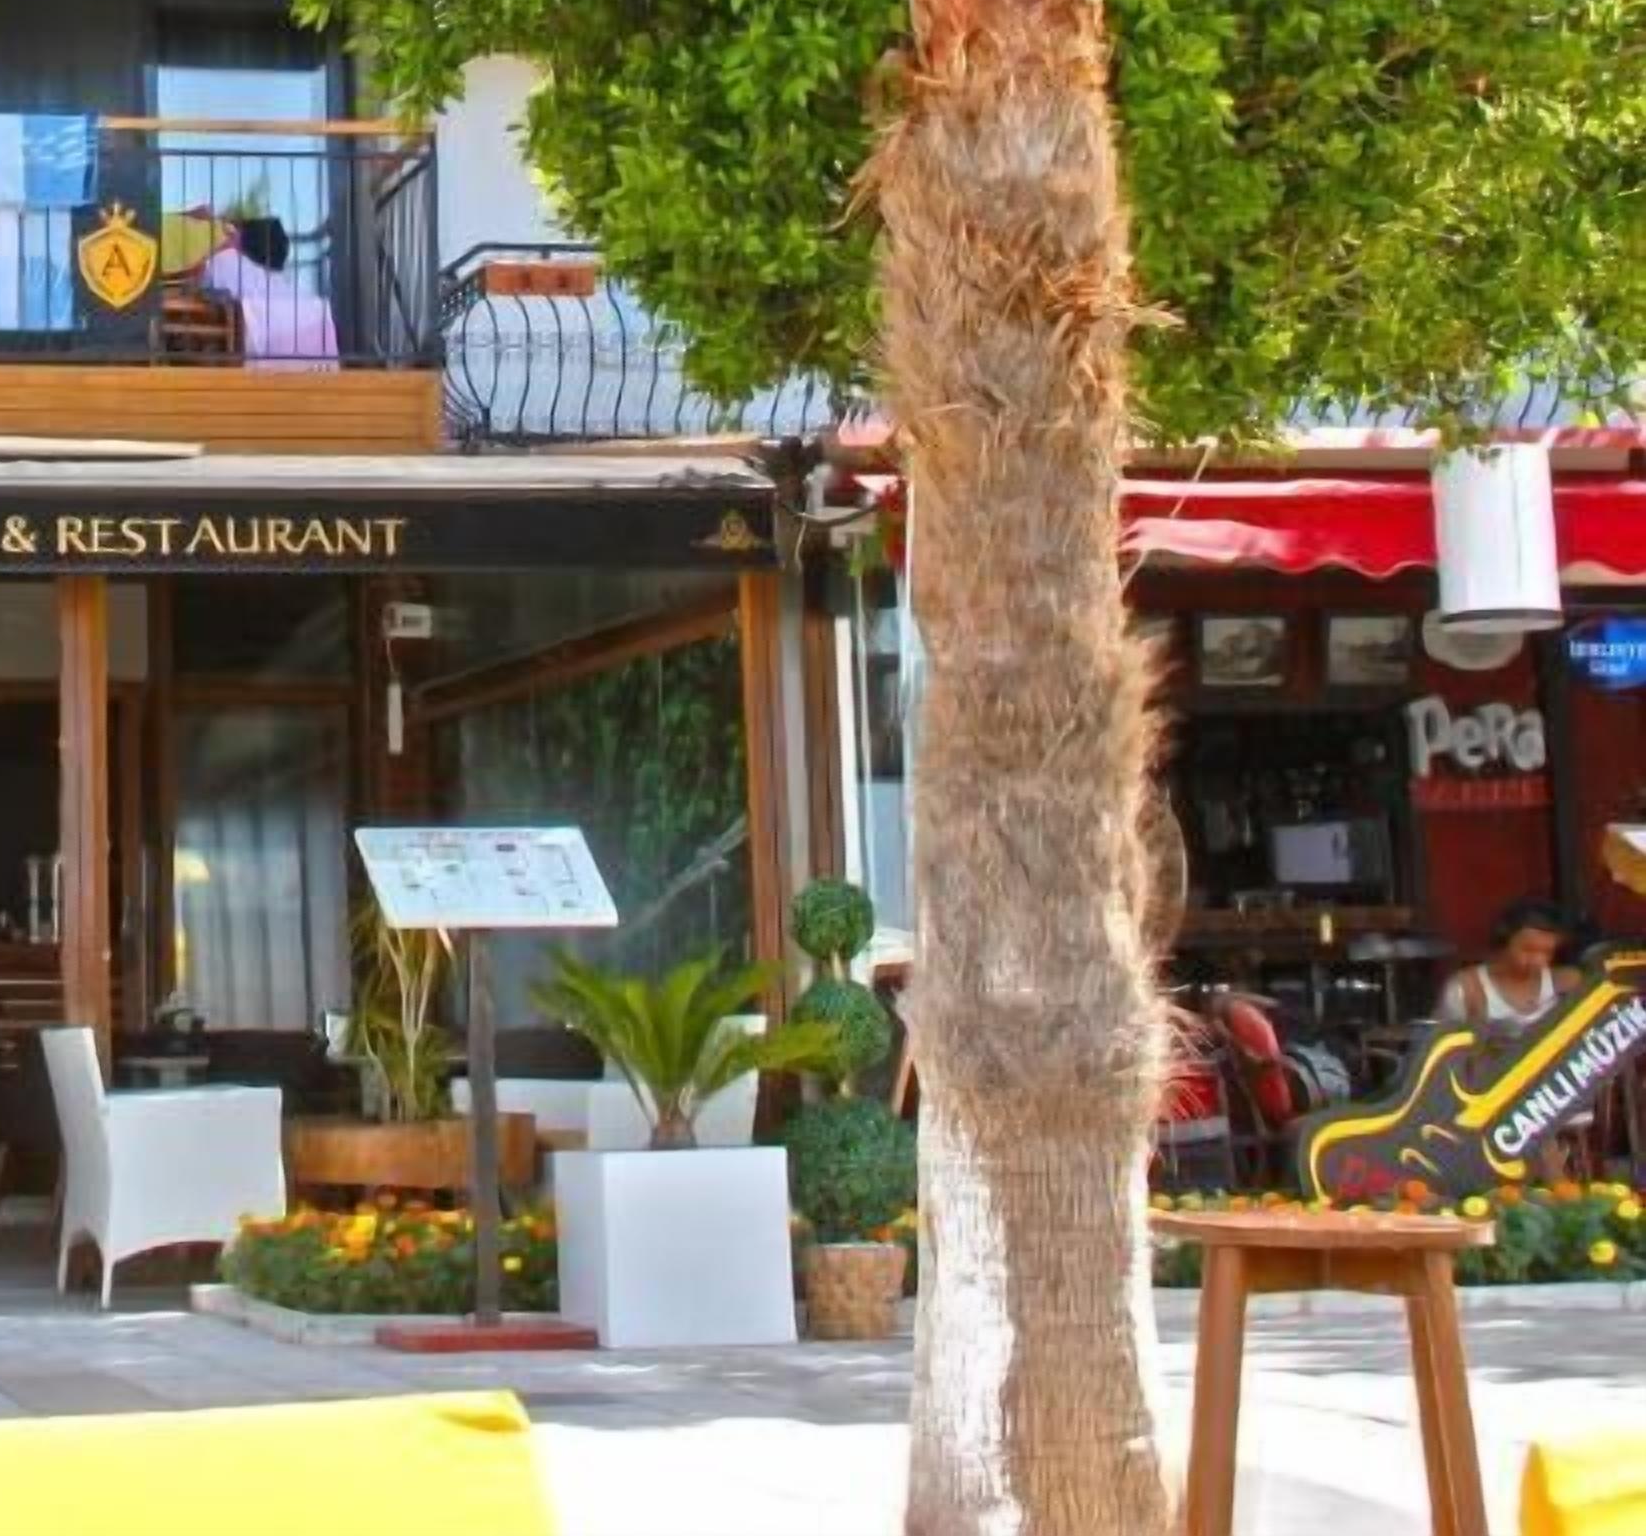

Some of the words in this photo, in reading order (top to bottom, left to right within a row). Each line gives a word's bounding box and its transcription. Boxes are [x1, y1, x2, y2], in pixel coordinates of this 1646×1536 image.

[102, 242, 131, 278] A
[1, 514, 38, 555] &
[56, 515, 407, 557] RESTAURANT
[1493, 1069, 1579, 1156] CANLI
